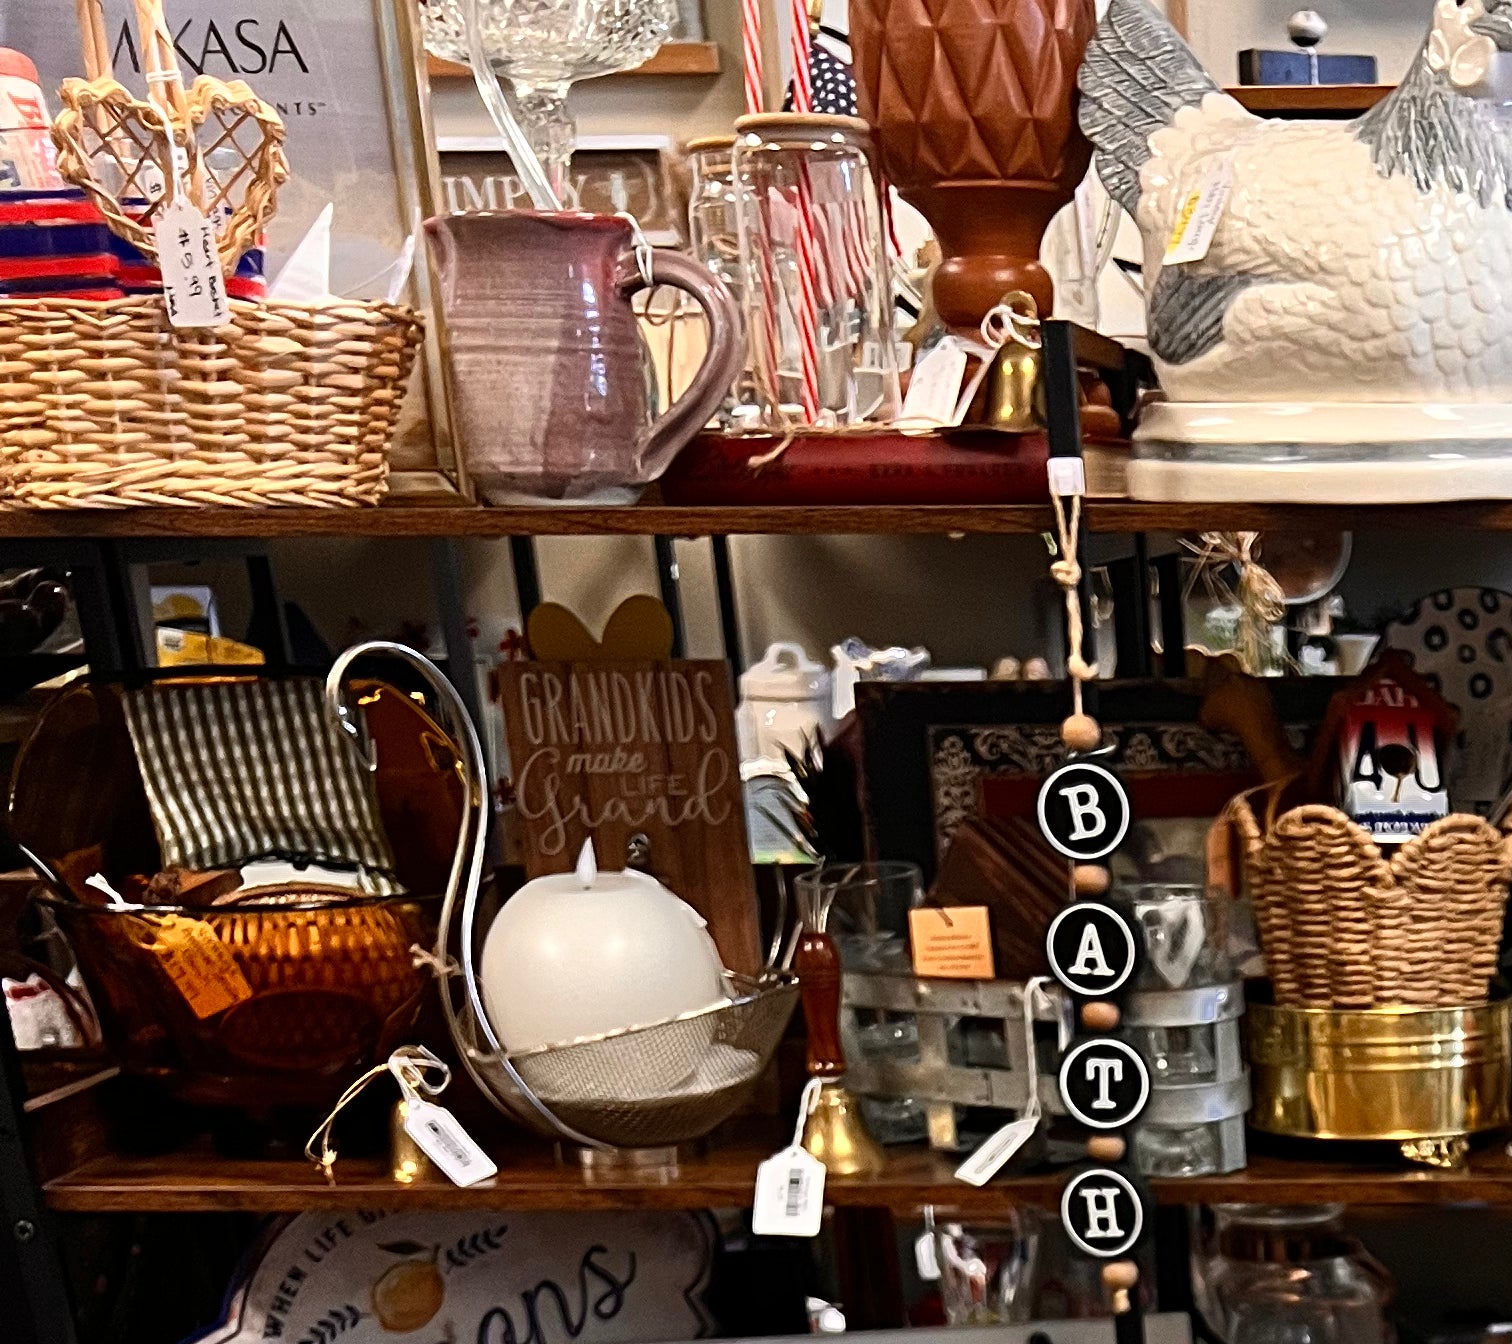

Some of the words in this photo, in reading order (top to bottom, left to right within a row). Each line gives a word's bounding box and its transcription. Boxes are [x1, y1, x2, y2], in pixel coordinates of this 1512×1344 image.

[106, 18, 309, 76] MKASA
[519, 670, 719, 746] GRANDKIDS
[566, 748, 645, 774] make
[621, 773, 689, 797] LIFE
[517, 748, 731, 856] Grand
